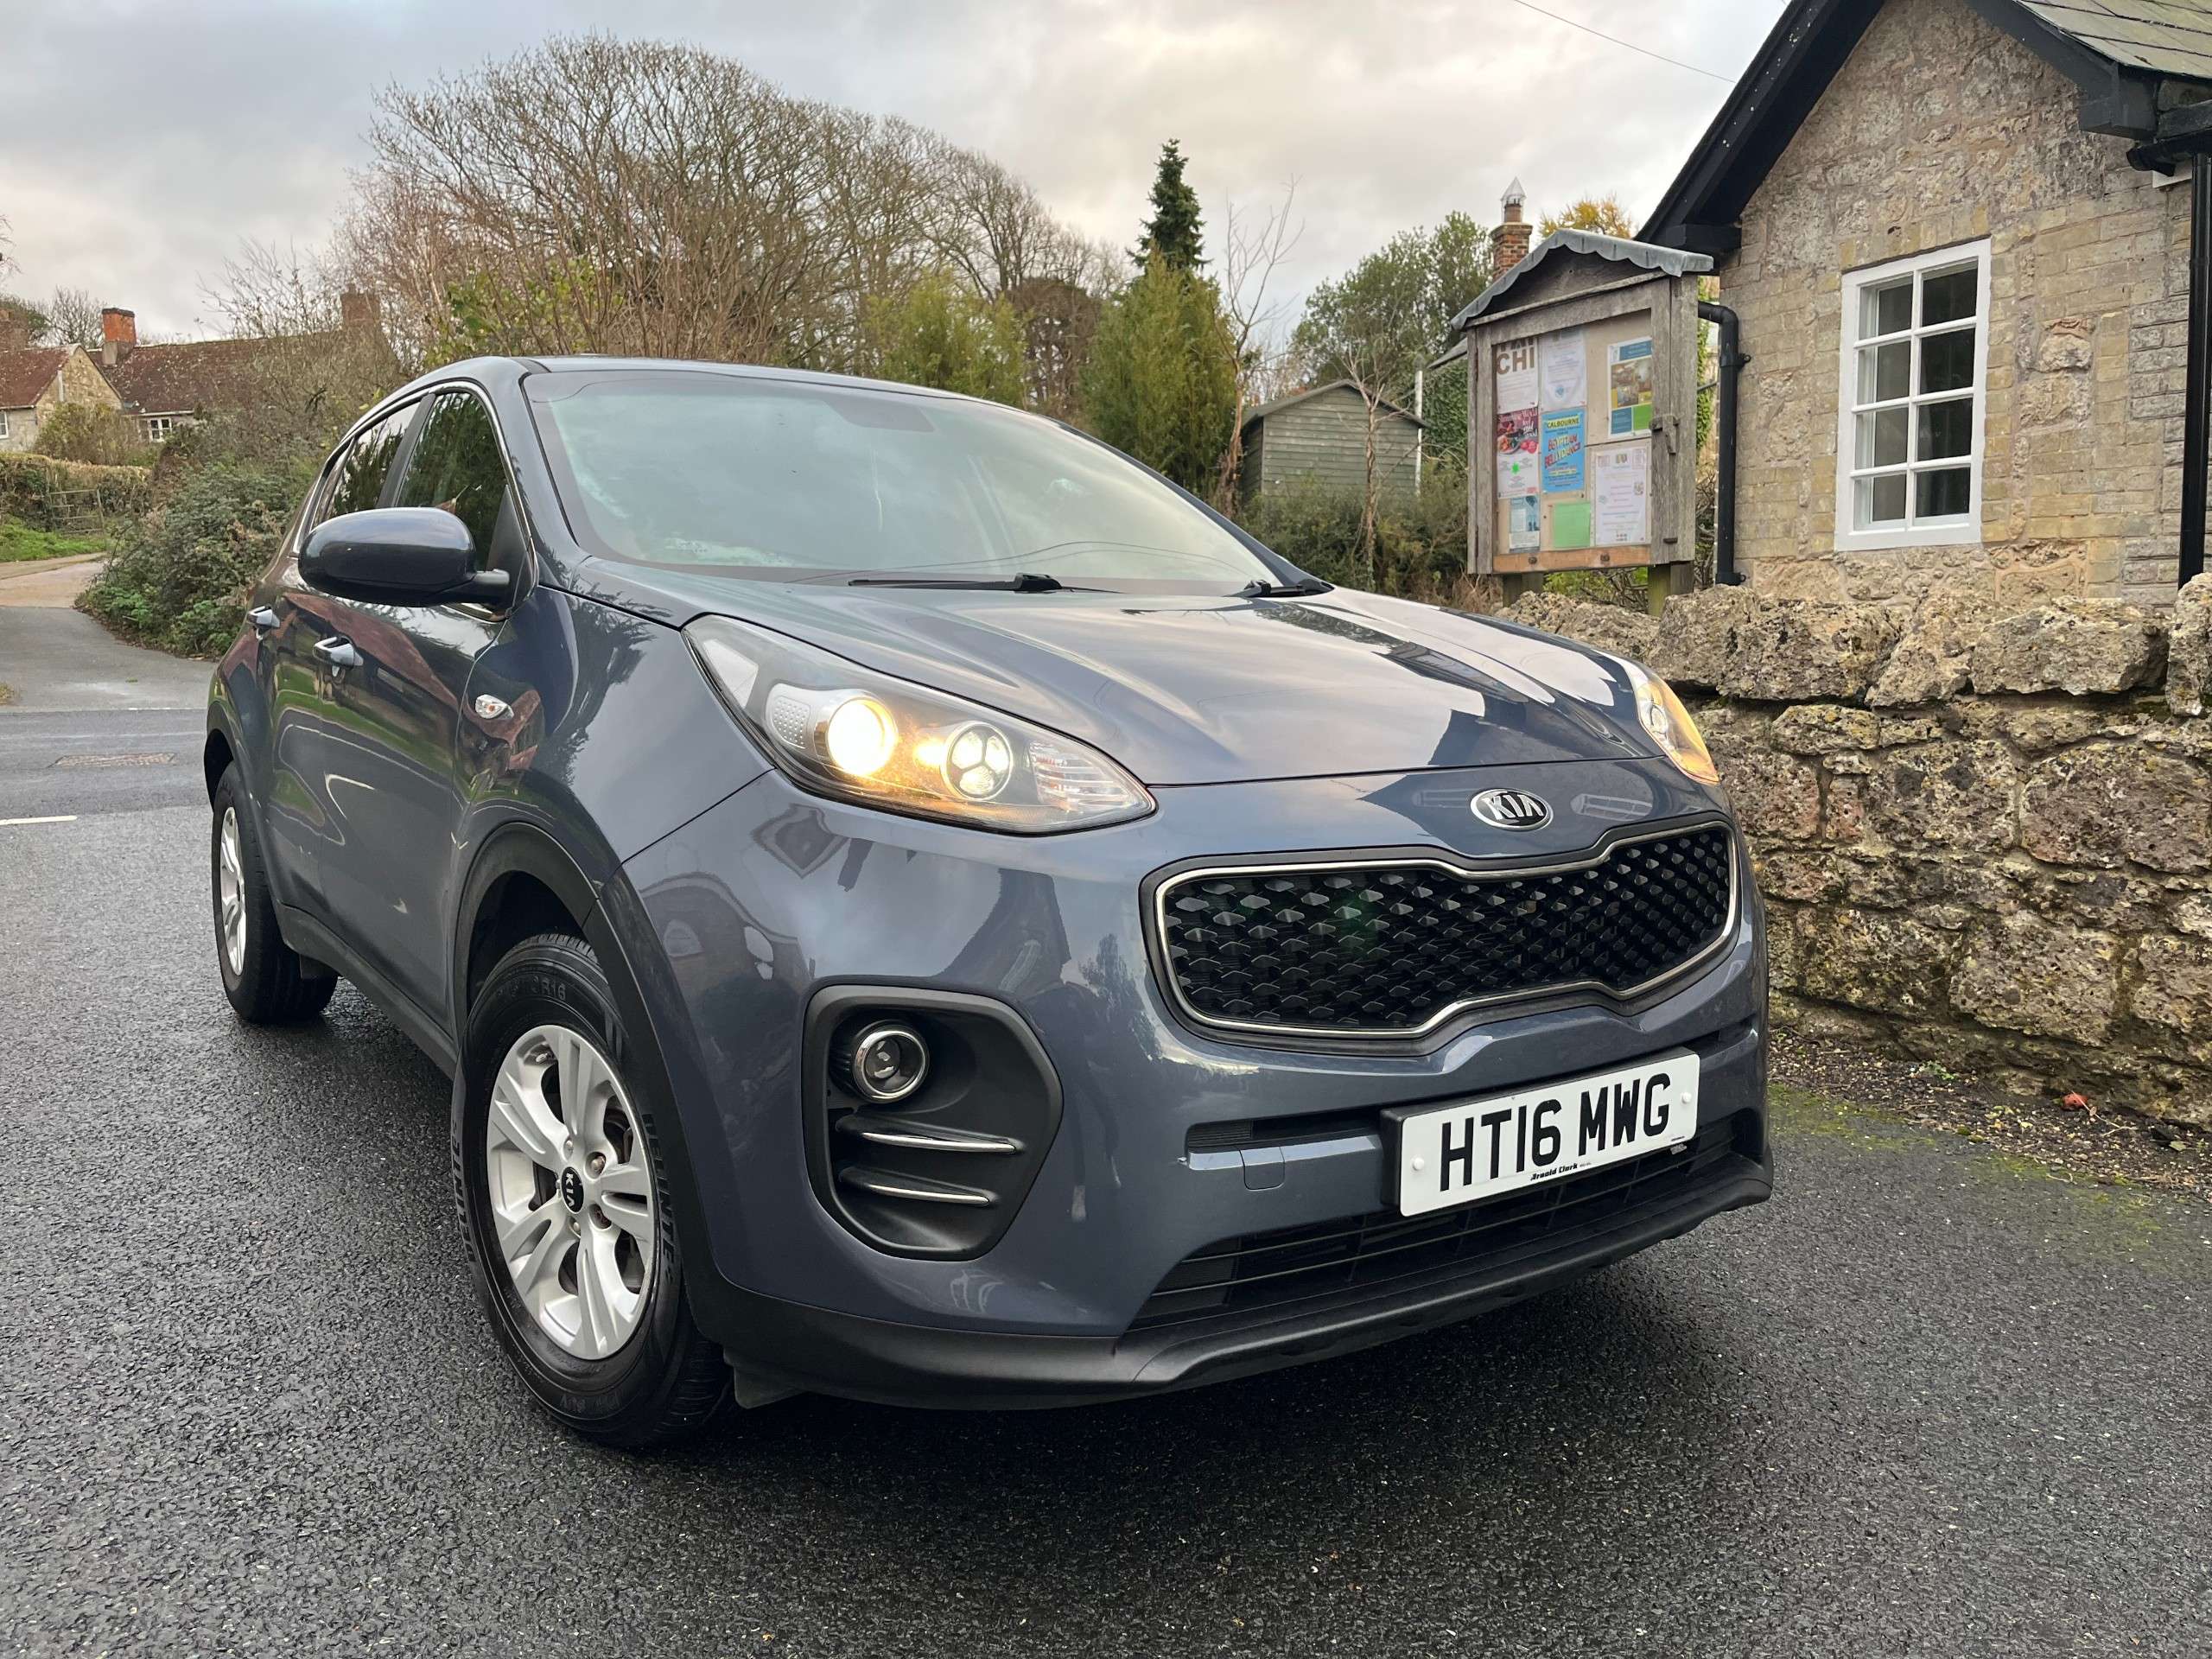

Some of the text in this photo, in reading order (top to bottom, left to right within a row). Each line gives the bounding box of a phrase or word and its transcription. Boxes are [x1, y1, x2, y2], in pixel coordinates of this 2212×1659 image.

[1497, 347, 1535, 375] CHI
[1481, 794, 1544, 820] KIA
[1440, 1072, 1671, 1192] HT16 MWG
[1529, 1162, 1578, 1181] Arnold Clark
[566, 1173, 575, 1207] KIA
